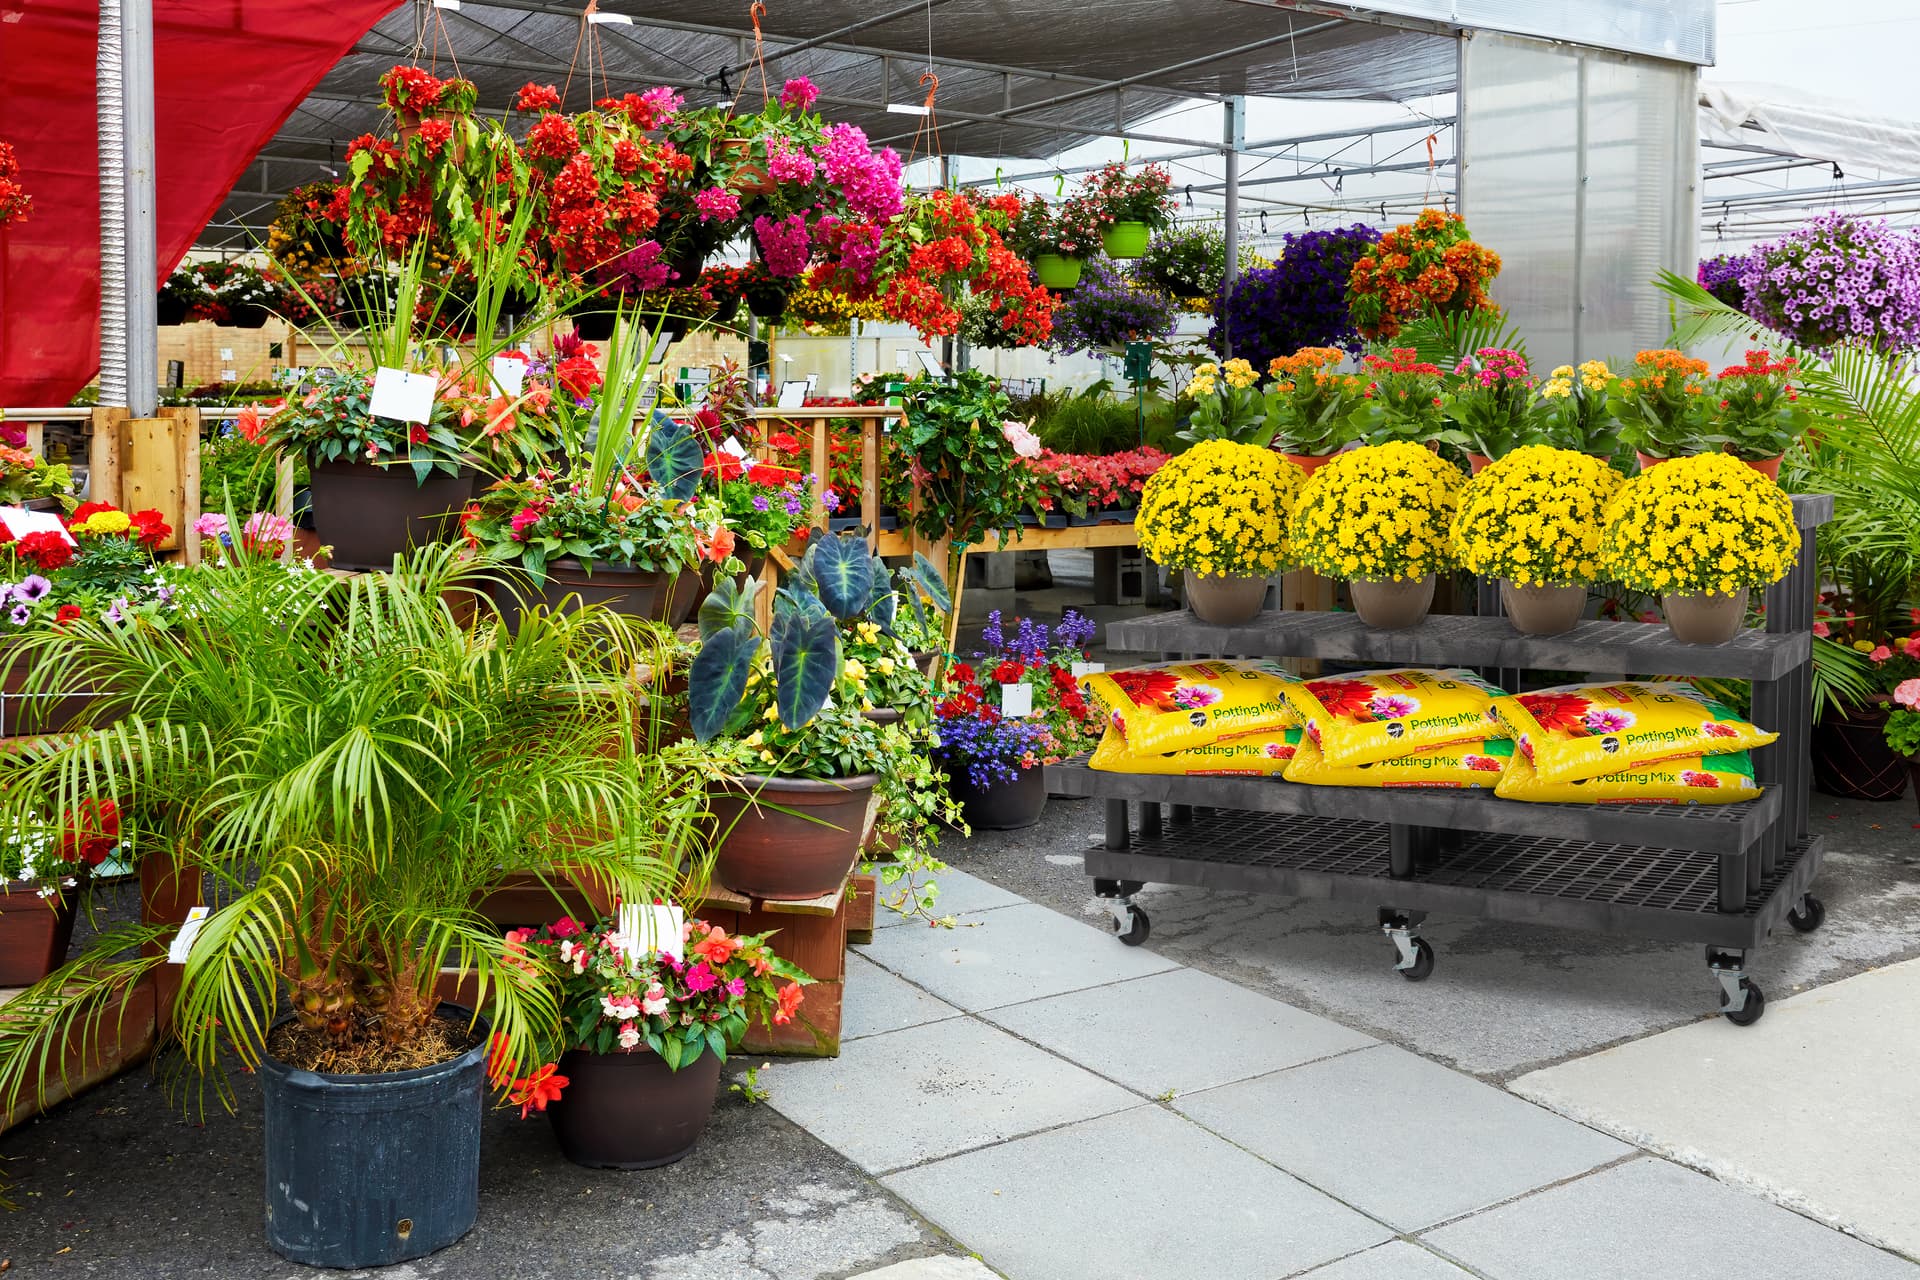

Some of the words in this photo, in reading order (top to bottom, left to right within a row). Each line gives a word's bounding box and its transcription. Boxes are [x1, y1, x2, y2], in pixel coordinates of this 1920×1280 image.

[1213, 705, 1260, 720] Potting
[1259, 702, 1281, 713] Mix
[1410, 716, 1459, 730] Potting
[1458, 712, 1481, 723] Mix
[1626, 731, 1676, 745] Potting
[1675, 727, 1699, 738] Mix
[1236, 745, 1260, 755] Mix
[1434, 757, 1458, 766] Mix
[1650, 772, 1676, 782] Mix
